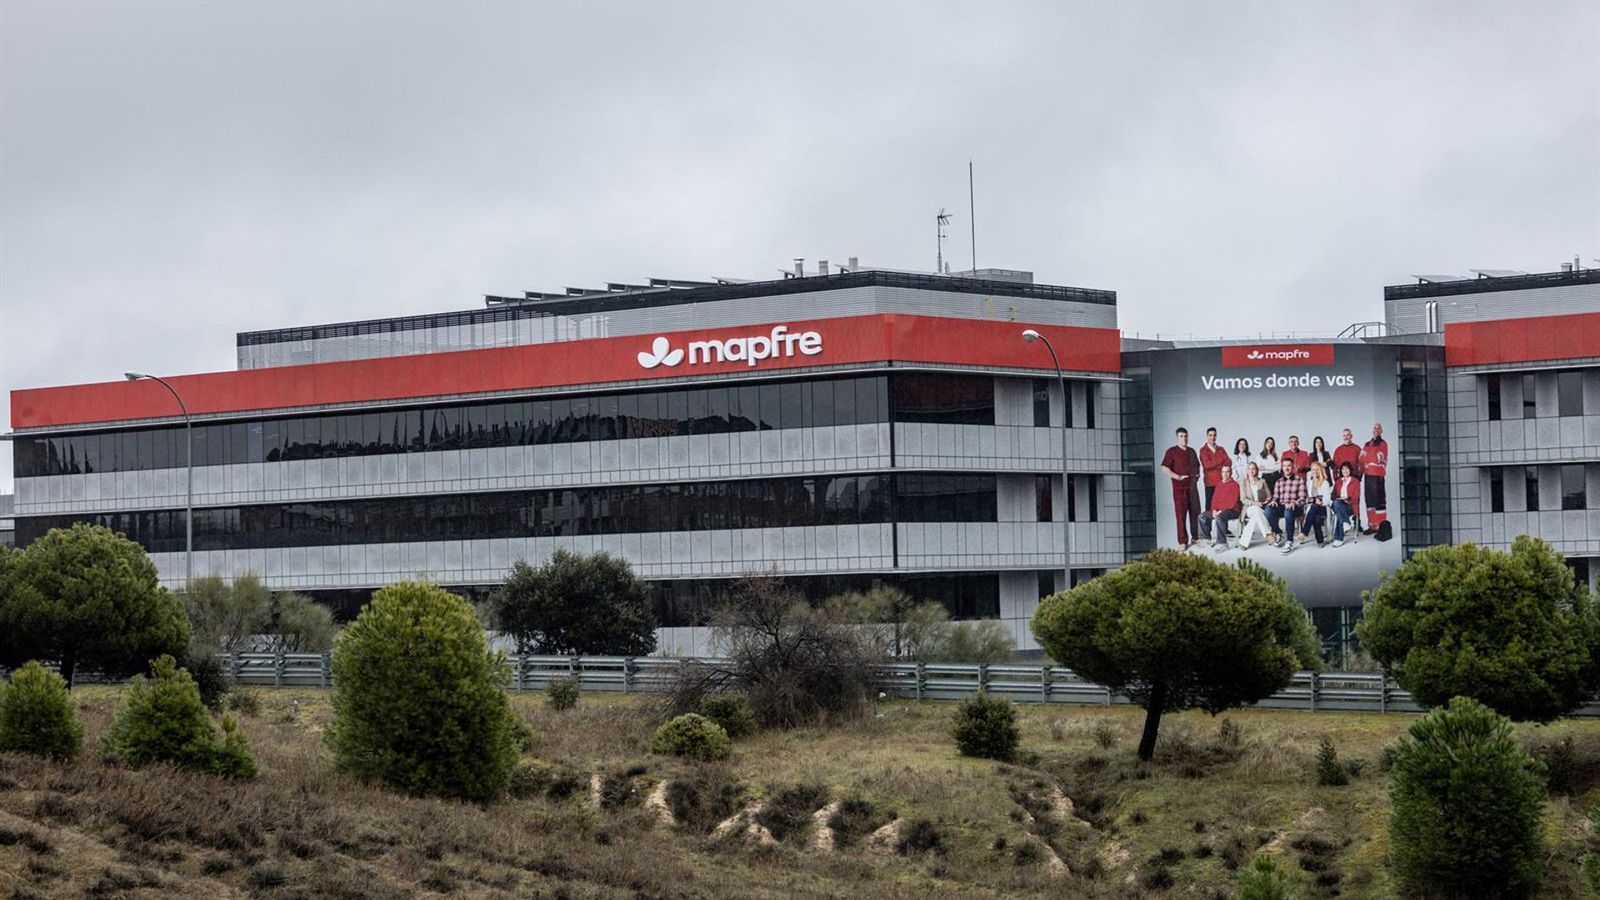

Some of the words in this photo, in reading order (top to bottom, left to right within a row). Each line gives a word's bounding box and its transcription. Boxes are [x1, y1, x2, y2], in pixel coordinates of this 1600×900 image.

[688, 325, 823, 366] mapfre
[1265, 349, 1310, 361] mapfre
[1201, 375, 1262, 390] Vamos
[1265, 373, 1321, 389] donde
[1326, 374, 1355, 387] vas
